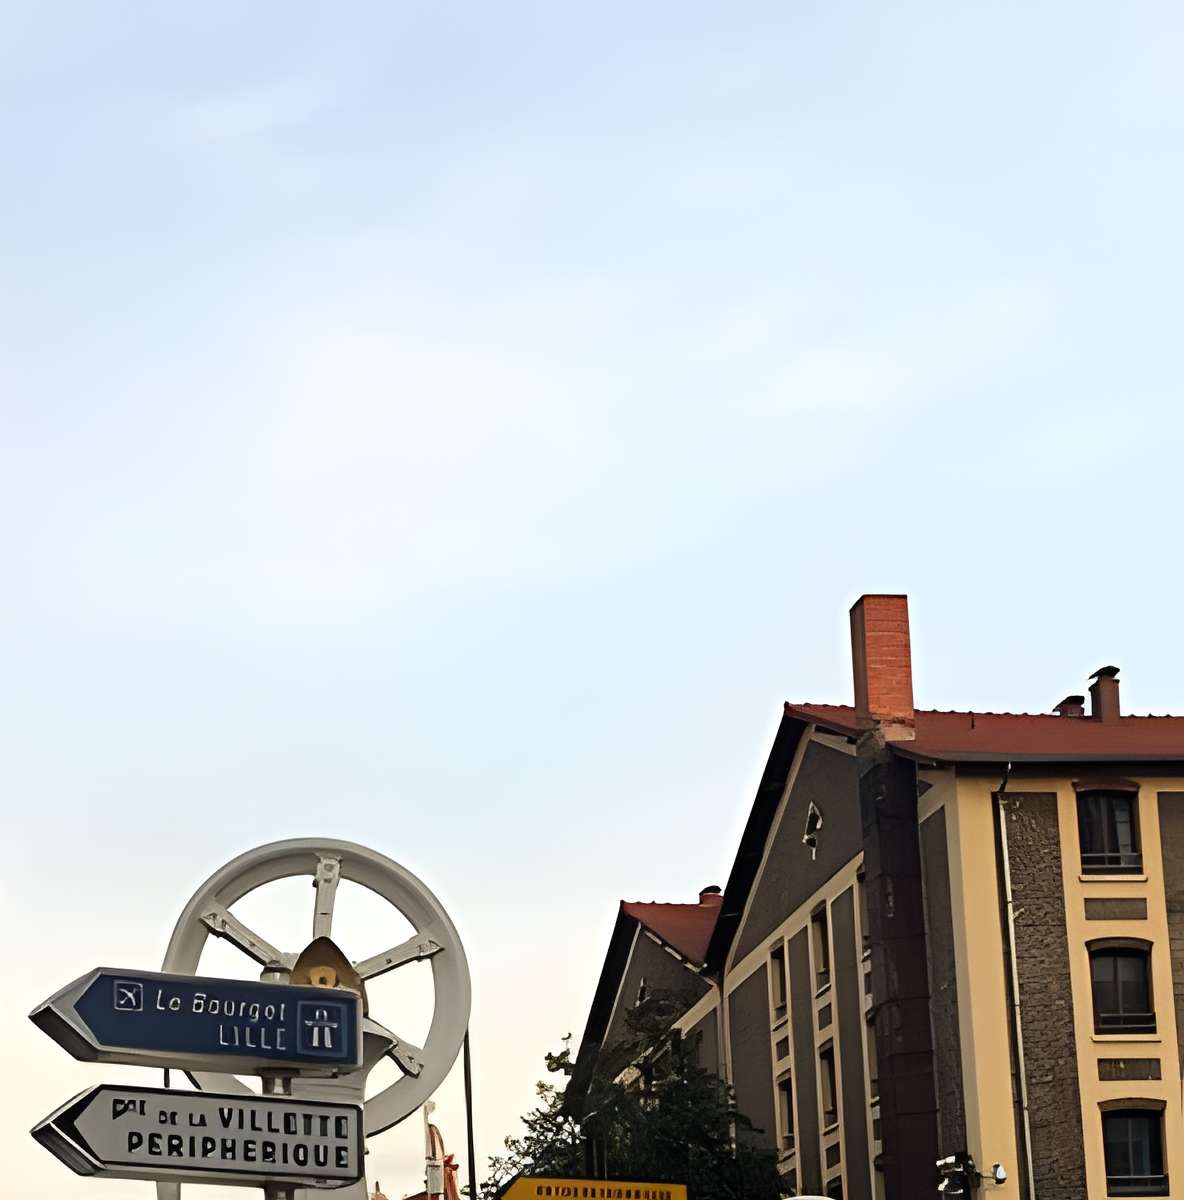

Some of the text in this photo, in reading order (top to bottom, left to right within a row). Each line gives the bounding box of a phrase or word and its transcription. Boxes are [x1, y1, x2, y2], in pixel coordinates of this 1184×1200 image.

[219, 1024, 287, 1050] LILLE
[218, 1107, 349, 1139] VILLETTE
[127, 1131, 349, 1169] PERIPHERIQUE
